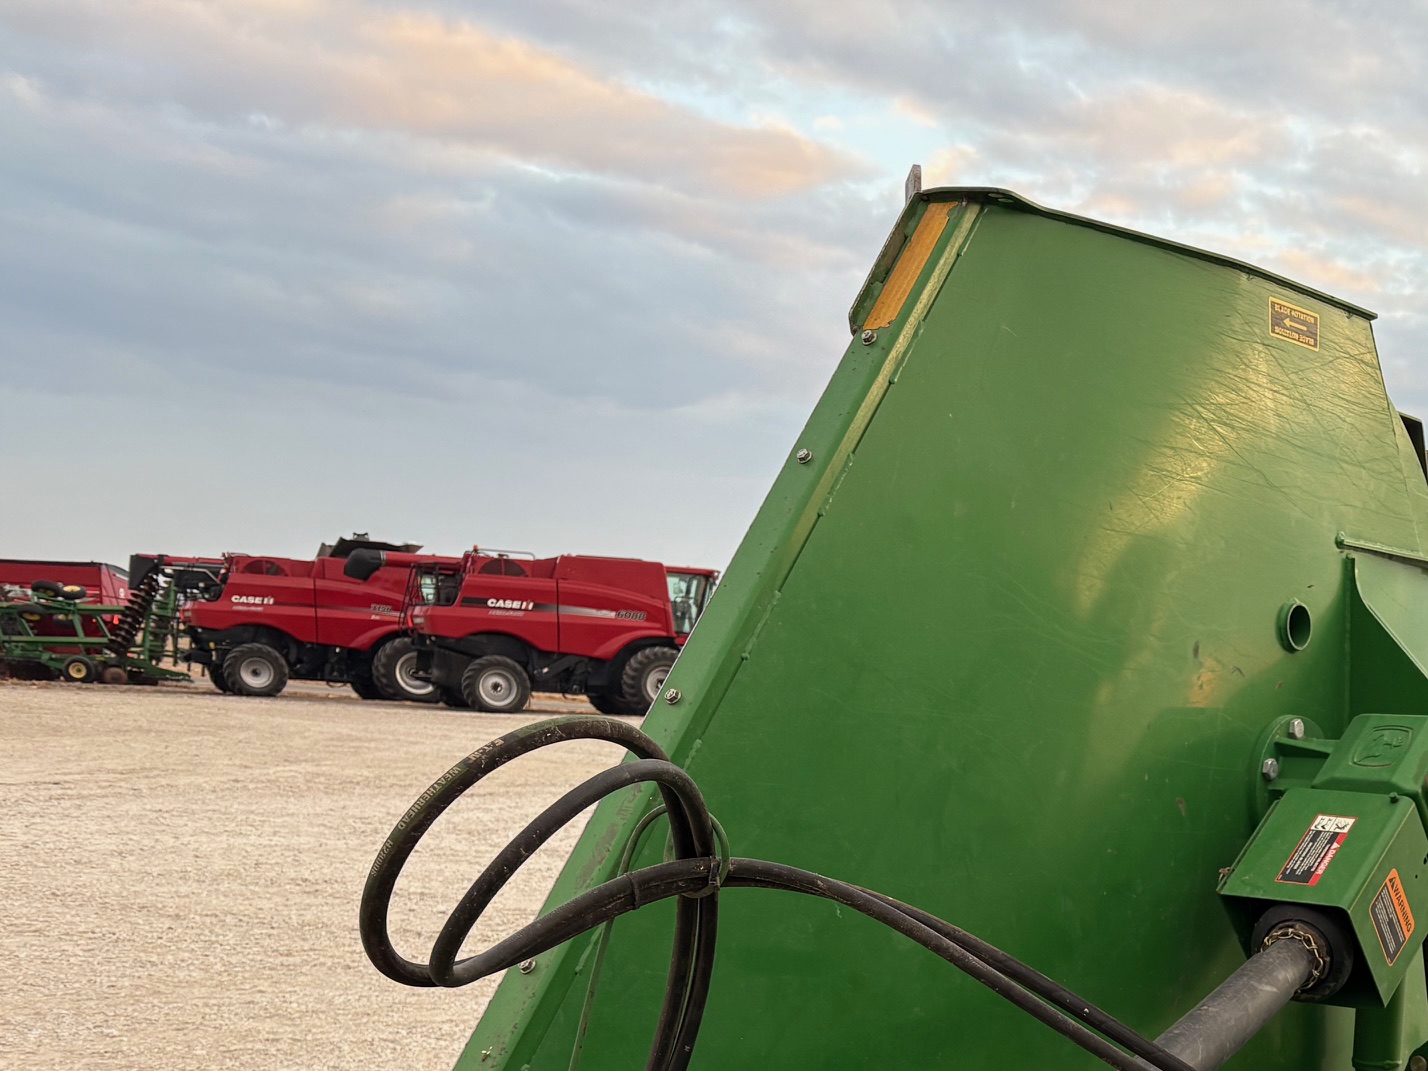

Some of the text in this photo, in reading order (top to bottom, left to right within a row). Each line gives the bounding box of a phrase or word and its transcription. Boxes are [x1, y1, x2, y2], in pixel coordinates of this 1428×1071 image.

[231, 595, 263, 604] CASE
[487, 598, 521, 610] CASE
[398, 766, 462, 830] WEATHERHEAD
[1316, 849, 1336, 875] DANGER
[1393, 884, 1412, 932] WARNING
